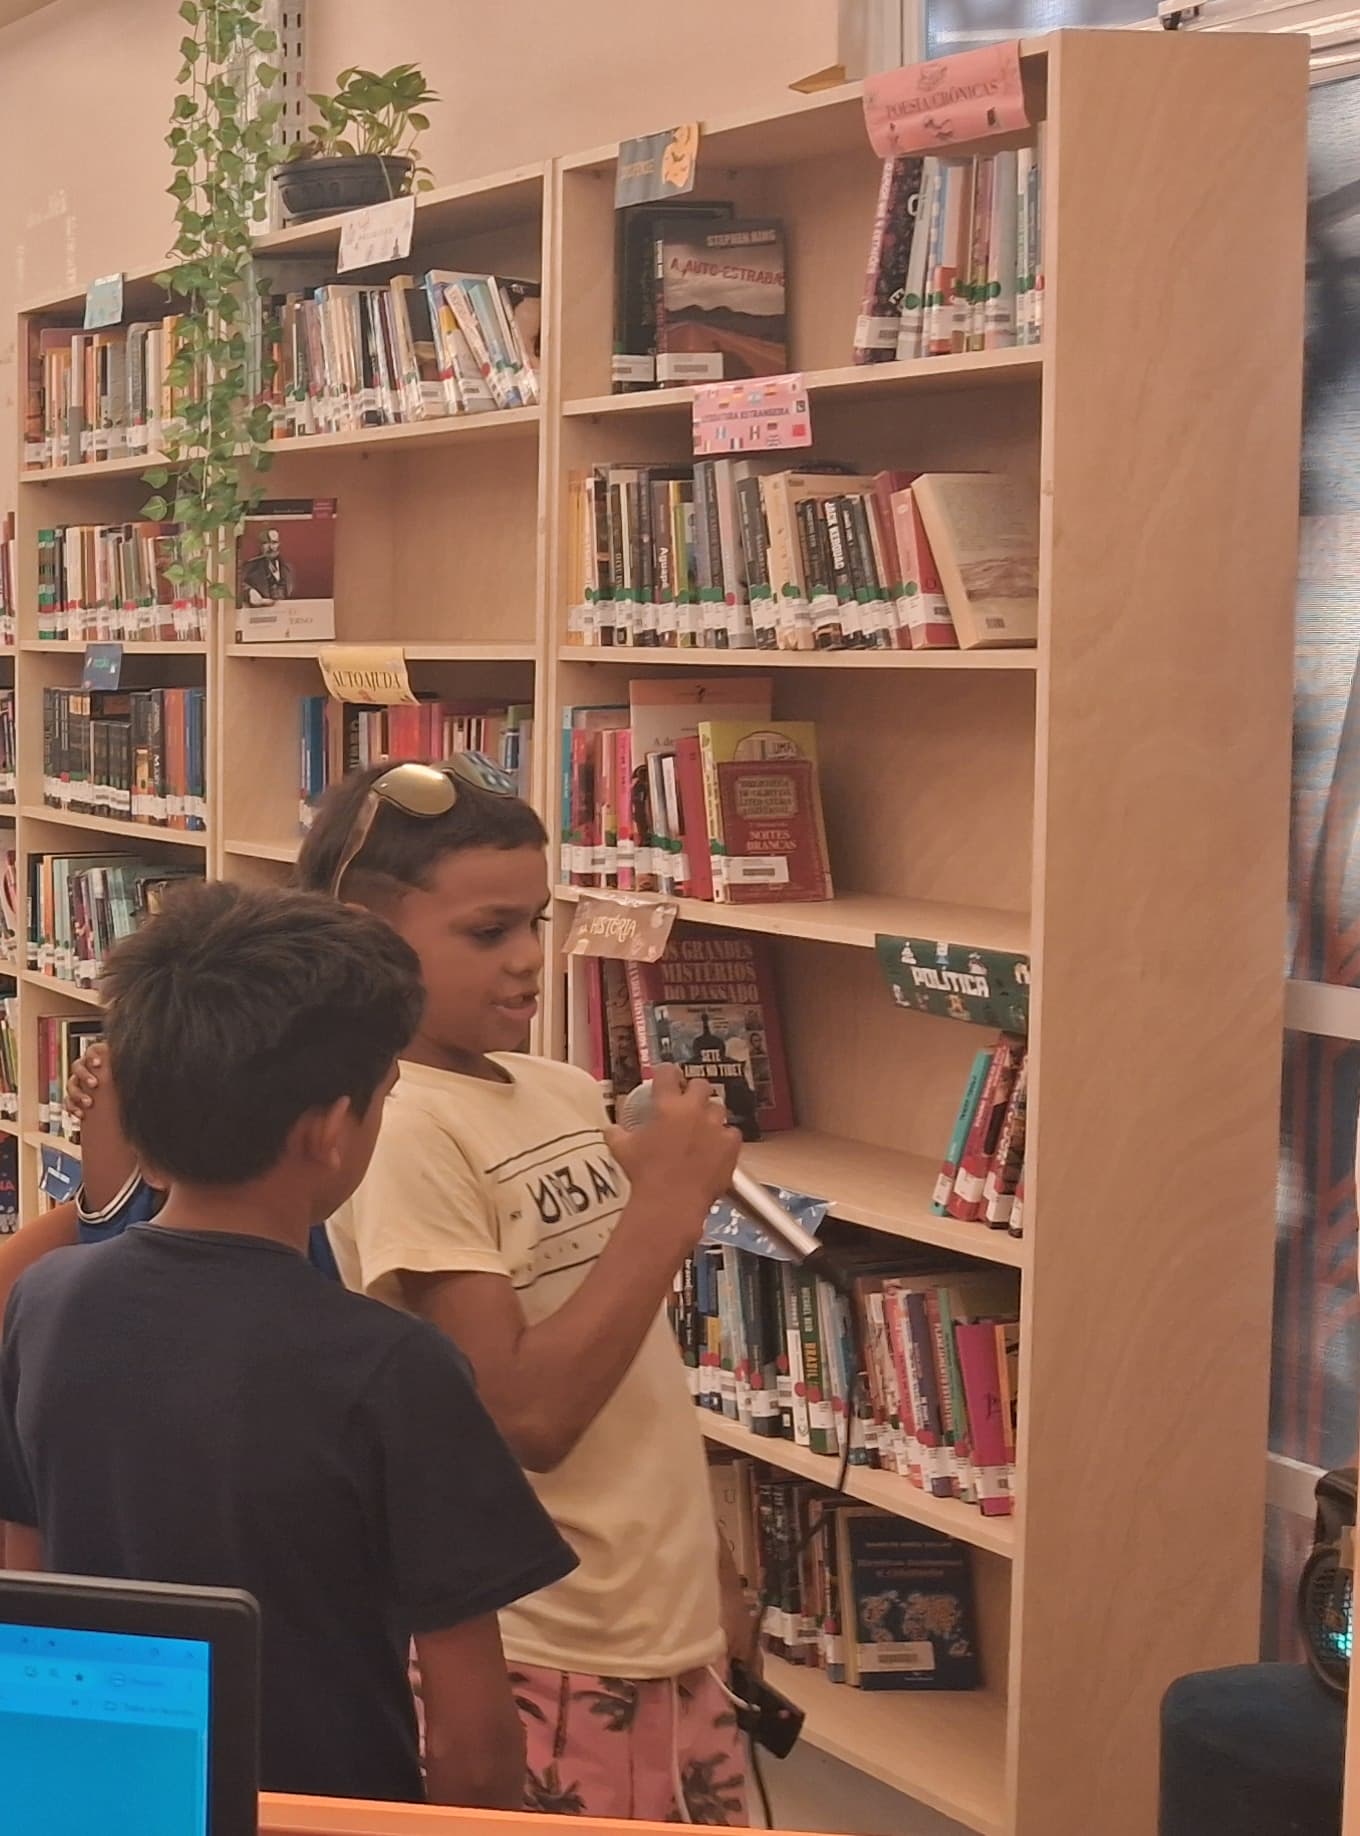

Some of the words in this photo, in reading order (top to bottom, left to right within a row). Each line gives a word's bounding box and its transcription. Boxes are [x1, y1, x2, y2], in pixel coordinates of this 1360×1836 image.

[751, 229, 776, 244] KING
[670, 257, 680, 270] A
[829, 526, 845, 570] KEROUAC
[332, 671, 401, 692] AUTOAJUDA
[590, 914, 636, 943] HISTÓRIA
[681, 938, 753, 961] GRANDES
[663, 959, 758, 983] MISTÉRIOS
[910, 965, 990, 998] POLÍTICA
[687, 984, 759, 1003] PASSADO
[701, 1049, 721, 1062] SETE
[526, 1155, 618, 1224] UBA
[804, 1342, 818, 1379] BRASIL
